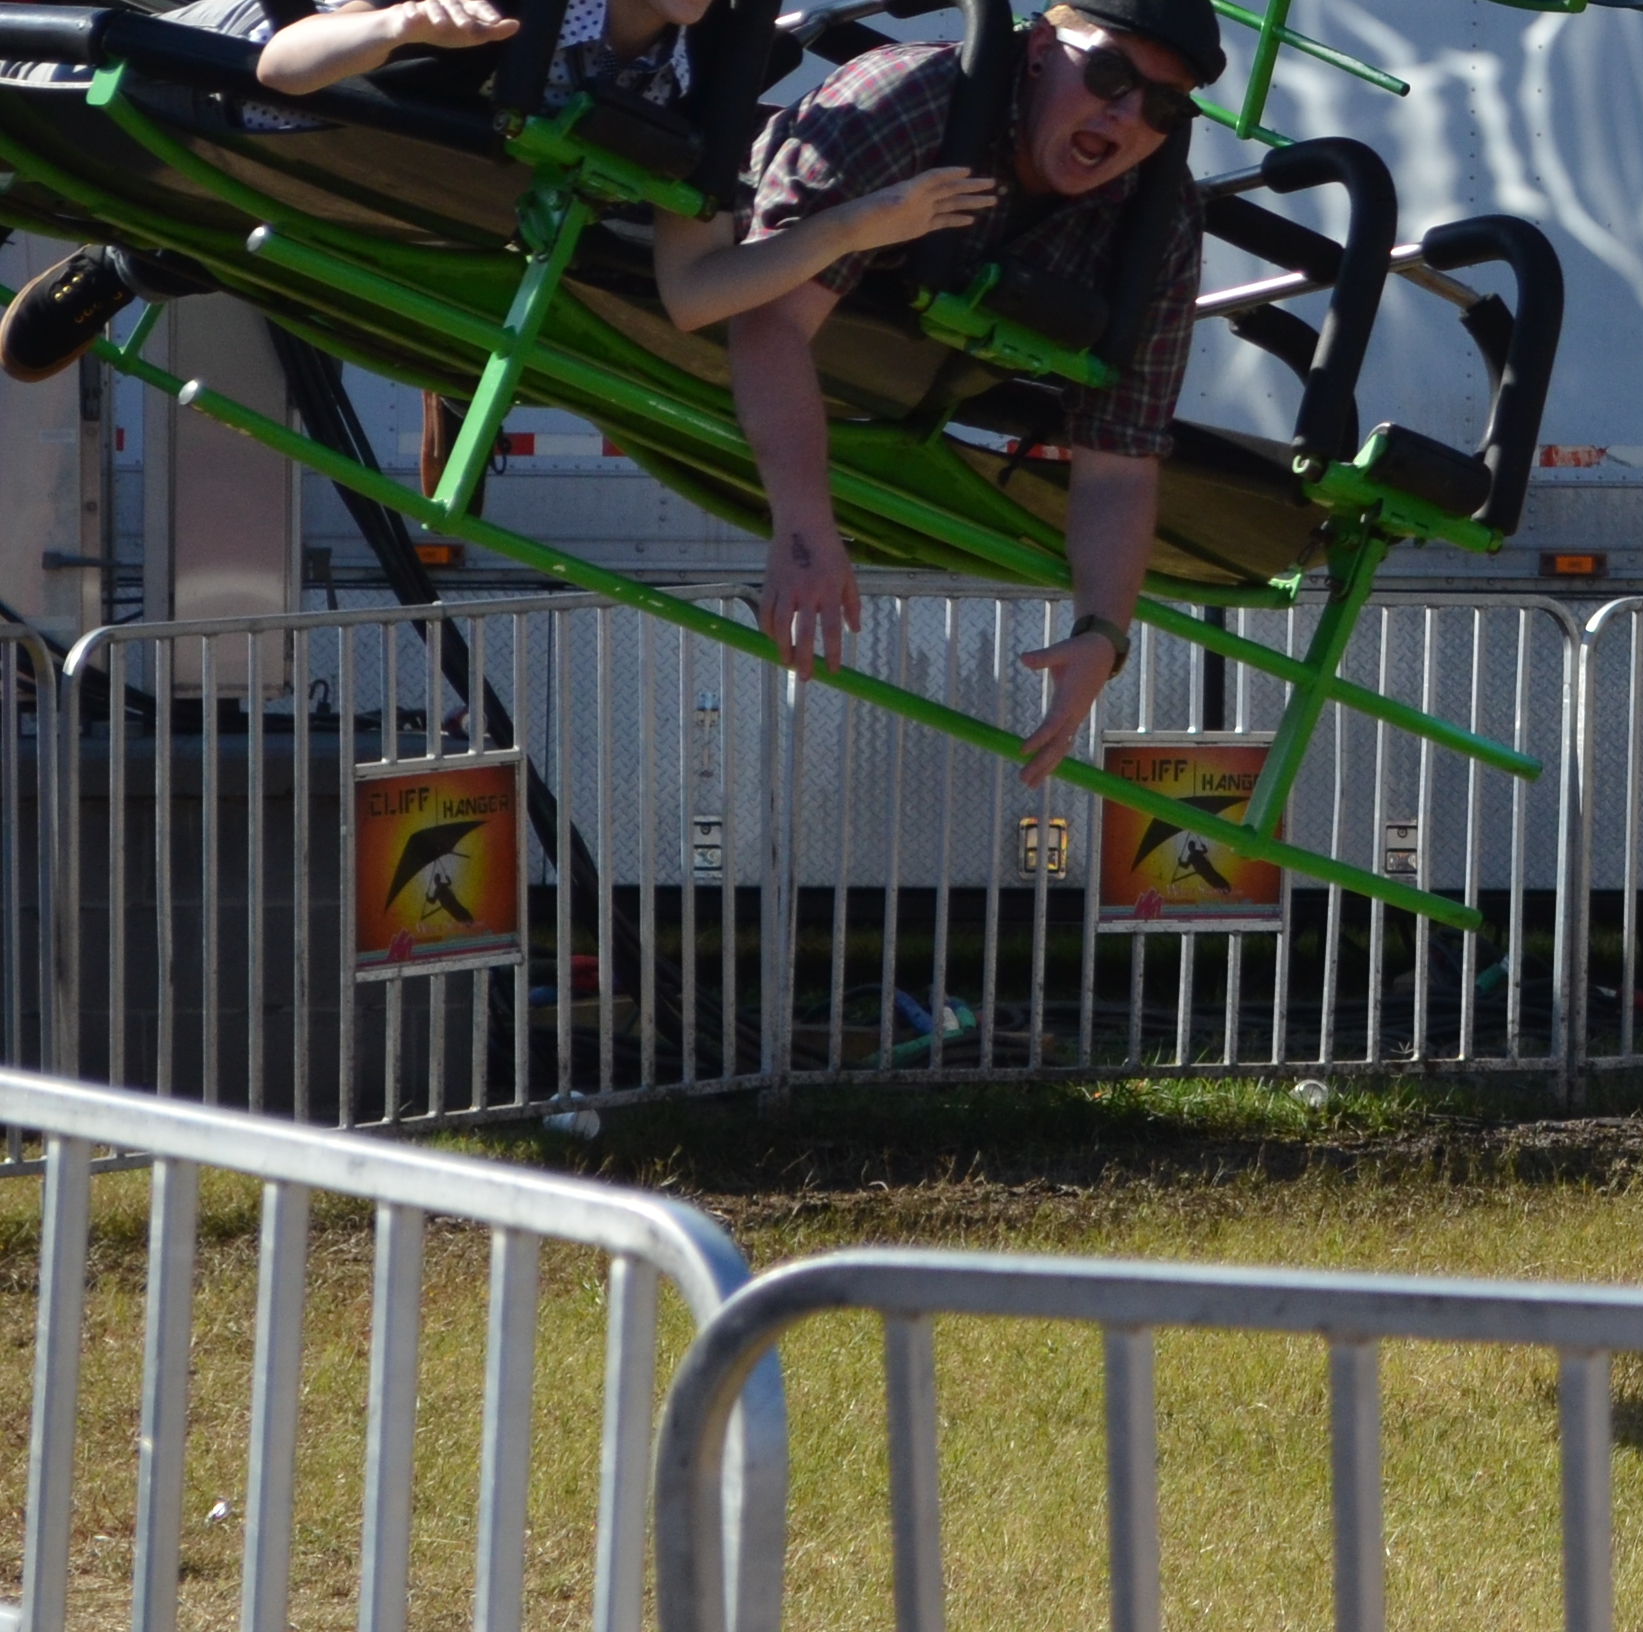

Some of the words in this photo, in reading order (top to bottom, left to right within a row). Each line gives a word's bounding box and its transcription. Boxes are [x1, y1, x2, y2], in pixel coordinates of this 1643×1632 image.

[1121, 759, 1188, 782] CLIFF
[1201, 773, 1260, 791] HANG
[370, 787, 430, 816] CLIFF
[443, 794, 511, 818] HANGER
